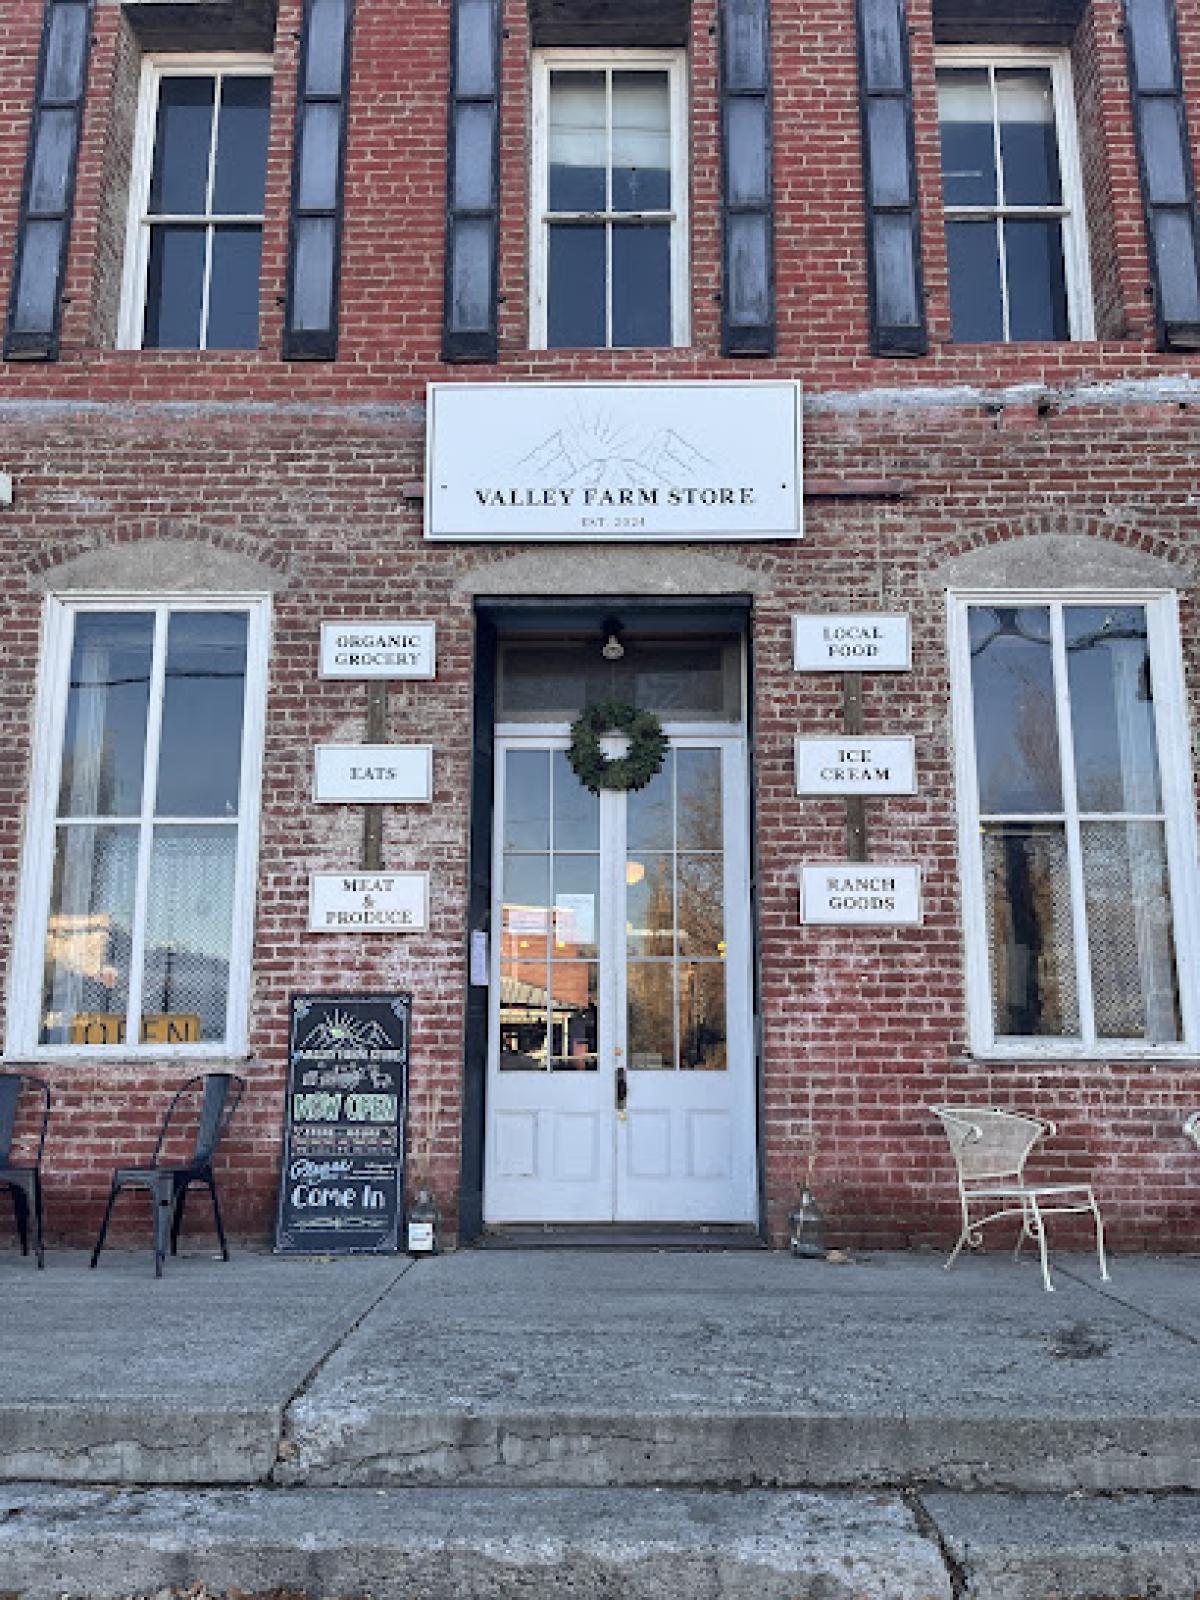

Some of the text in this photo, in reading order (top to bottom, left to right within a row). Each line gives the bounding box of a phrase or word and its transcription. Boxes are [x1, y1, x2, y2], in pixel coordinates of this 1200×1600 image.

[474, 487, 756, 506] VALLEY FARM STORE
[335, 634, 421, 648] ORGANIC
[823, 626, 883, 641] LOCAL
[828, 643, 879, 658] FOOD
[335, 652, 421, 666] GROCERY
[838, 749, 871, 763] ICE
[350, 767, 397, 781] EATS
[820, 766, 890, 782] CREAM
[341, 878, 395, 892] MEAT
[827, 877, 895, 892] RANCH
[361, 894, 376, 909] &
[828, 896, 895, 911] GOODS
[325, 911, 413, 925] PRODUCE
[345, 1093, 397, 1121] OPEN
[291, 1185, 387, 1209] Come In
